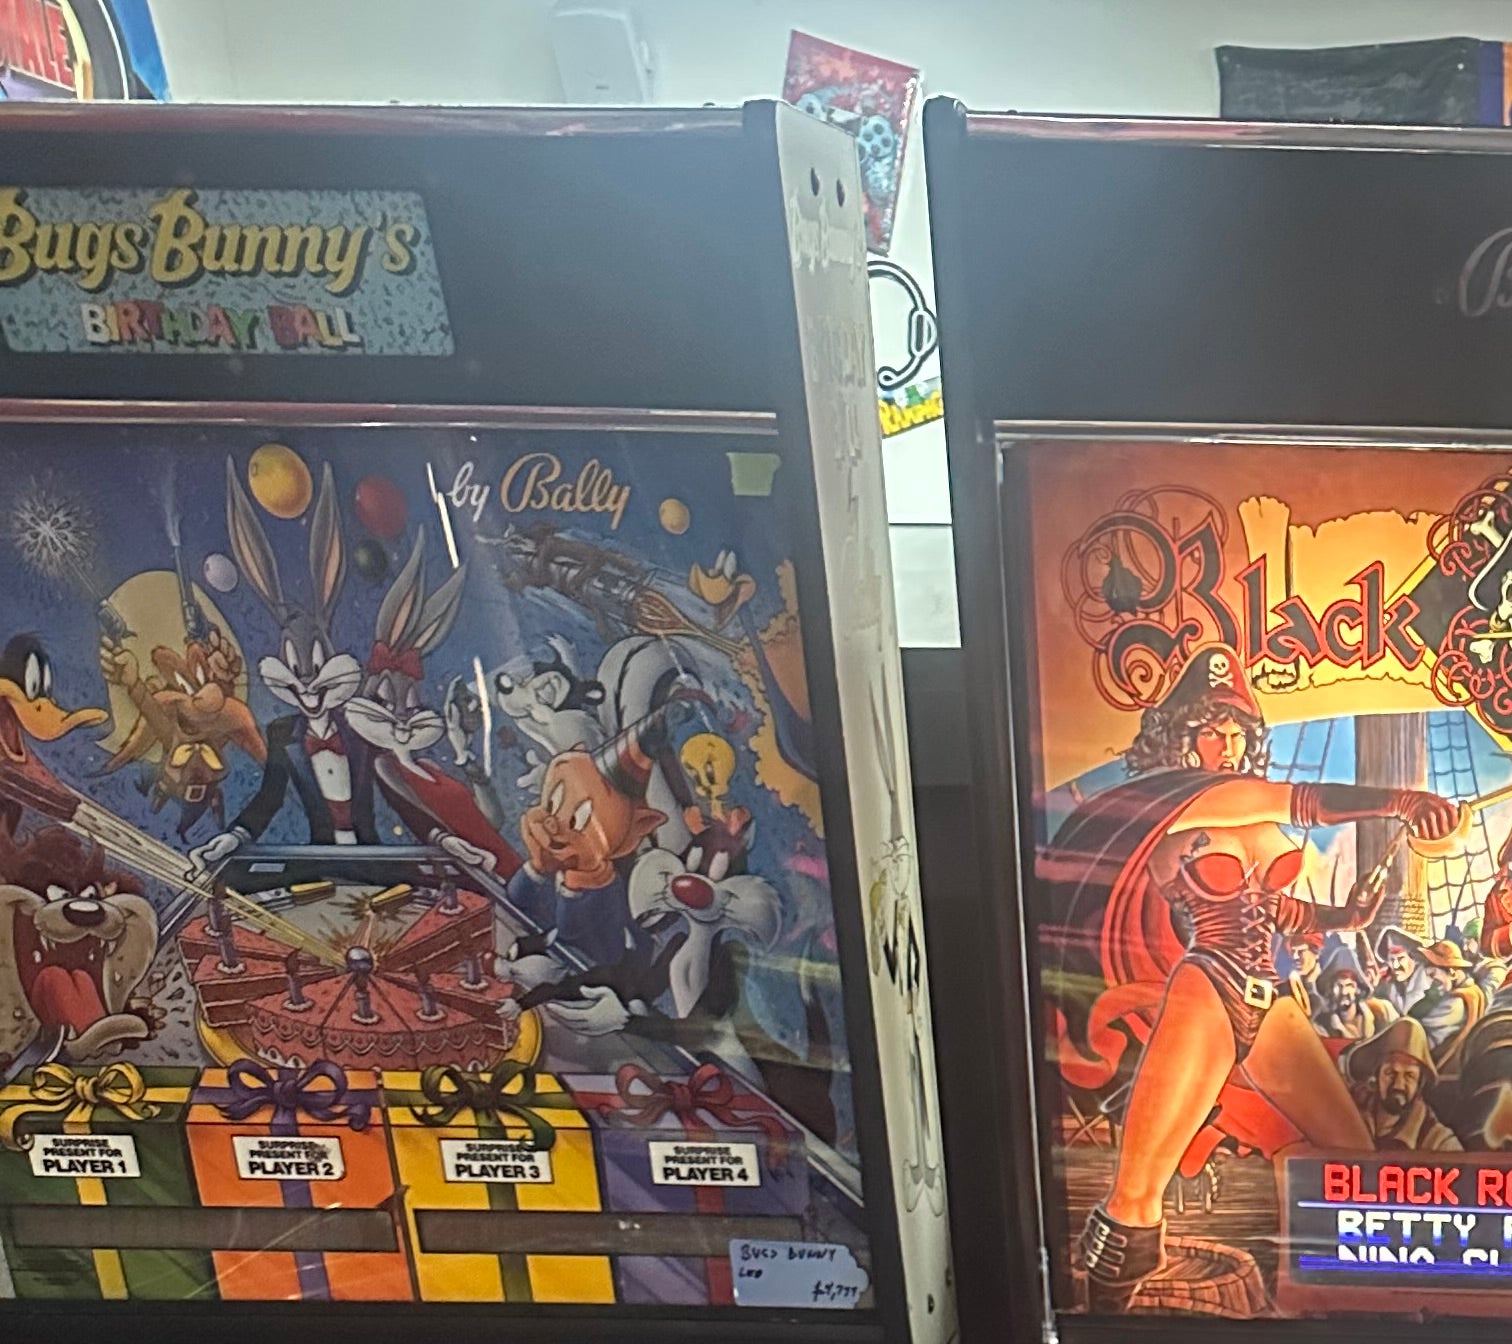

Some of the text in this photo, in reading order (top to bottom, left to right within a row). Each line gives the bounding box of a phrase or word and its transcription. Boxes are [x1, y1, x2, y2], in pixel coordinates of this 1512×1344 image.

[0, 187, 419, 297] Bugs Bunny's
[80, 301, 363, 349] BIRTHDAY BALL
[446, 453, 631, 530] by Bally
[1064, 490, 1427, 704] Black
[52, 1138, 109, 1148] SURPRISE
[674, 1145, 731, 1155] SURPRISE
[43, 1148, 123, 1157] PRESENT FOR
[43, 1159, 127, 1173] PLAYER 1
[665, 1155, 743, 1165] PRESENT FOR
[249, 1161, 334, 1176] PLAYER 2
[456, 1164, 540, 1178] PLAYER 3
[663, 1167, 748, 1181] PLAYER 4
[1323, 1164, 1460, 1204] BLACK
[1337, 1210, 1476, 1246] BETTY
